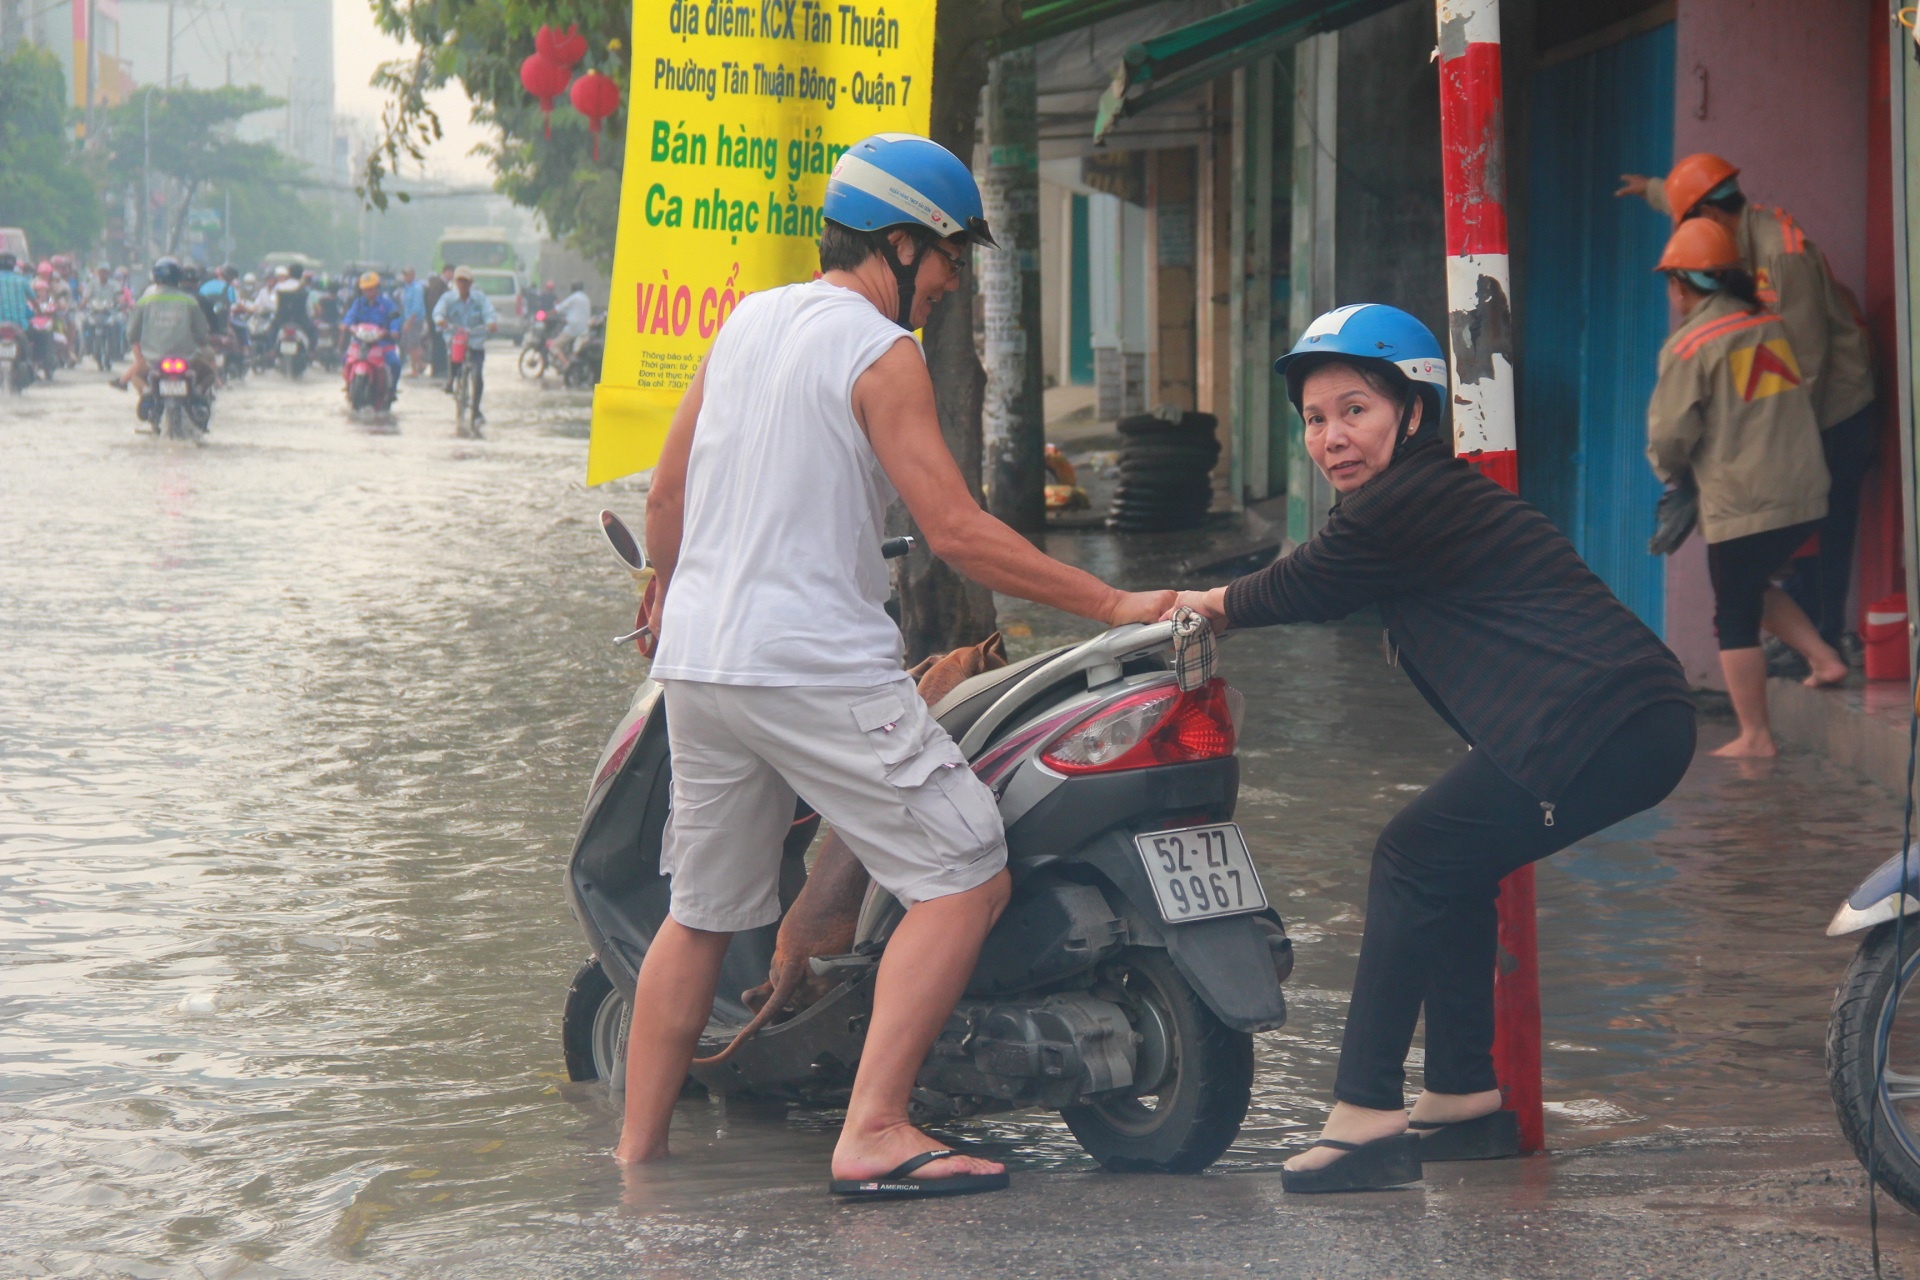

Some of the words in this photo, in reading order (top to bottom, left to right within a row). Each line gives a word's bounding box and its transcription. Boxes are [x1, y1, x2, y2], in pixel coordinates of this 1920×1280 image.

[670, 0, 699, 43] địa
[760, 0, 796, 39] KCX
[802, 1, 832, 43] Tân
[838, 5, 899, 57] Thuận
[654, 57, 717, 101] Phường
[722, 61, 749, 95] Tân
[753, 62, 795, 103] Thuận
[799, 66, 837, 110] Đông
[851, 70, 896, 112] Quận
[901, 75, 912, 106] 7
[650, 120, 707, 165] Bán
[716, 124, 777, 180] hàng
[645, 183, 683, 227] Ca
[693, 188, 759, 245] nhạc
[636, 269, 692, 337] VÀO
[698, 261, 755, 339] CỔ
[638, 379, 651, 387] Địa
[641, 351, 666, 361] Thông
[1169, 870, 1244, 914] 9967
